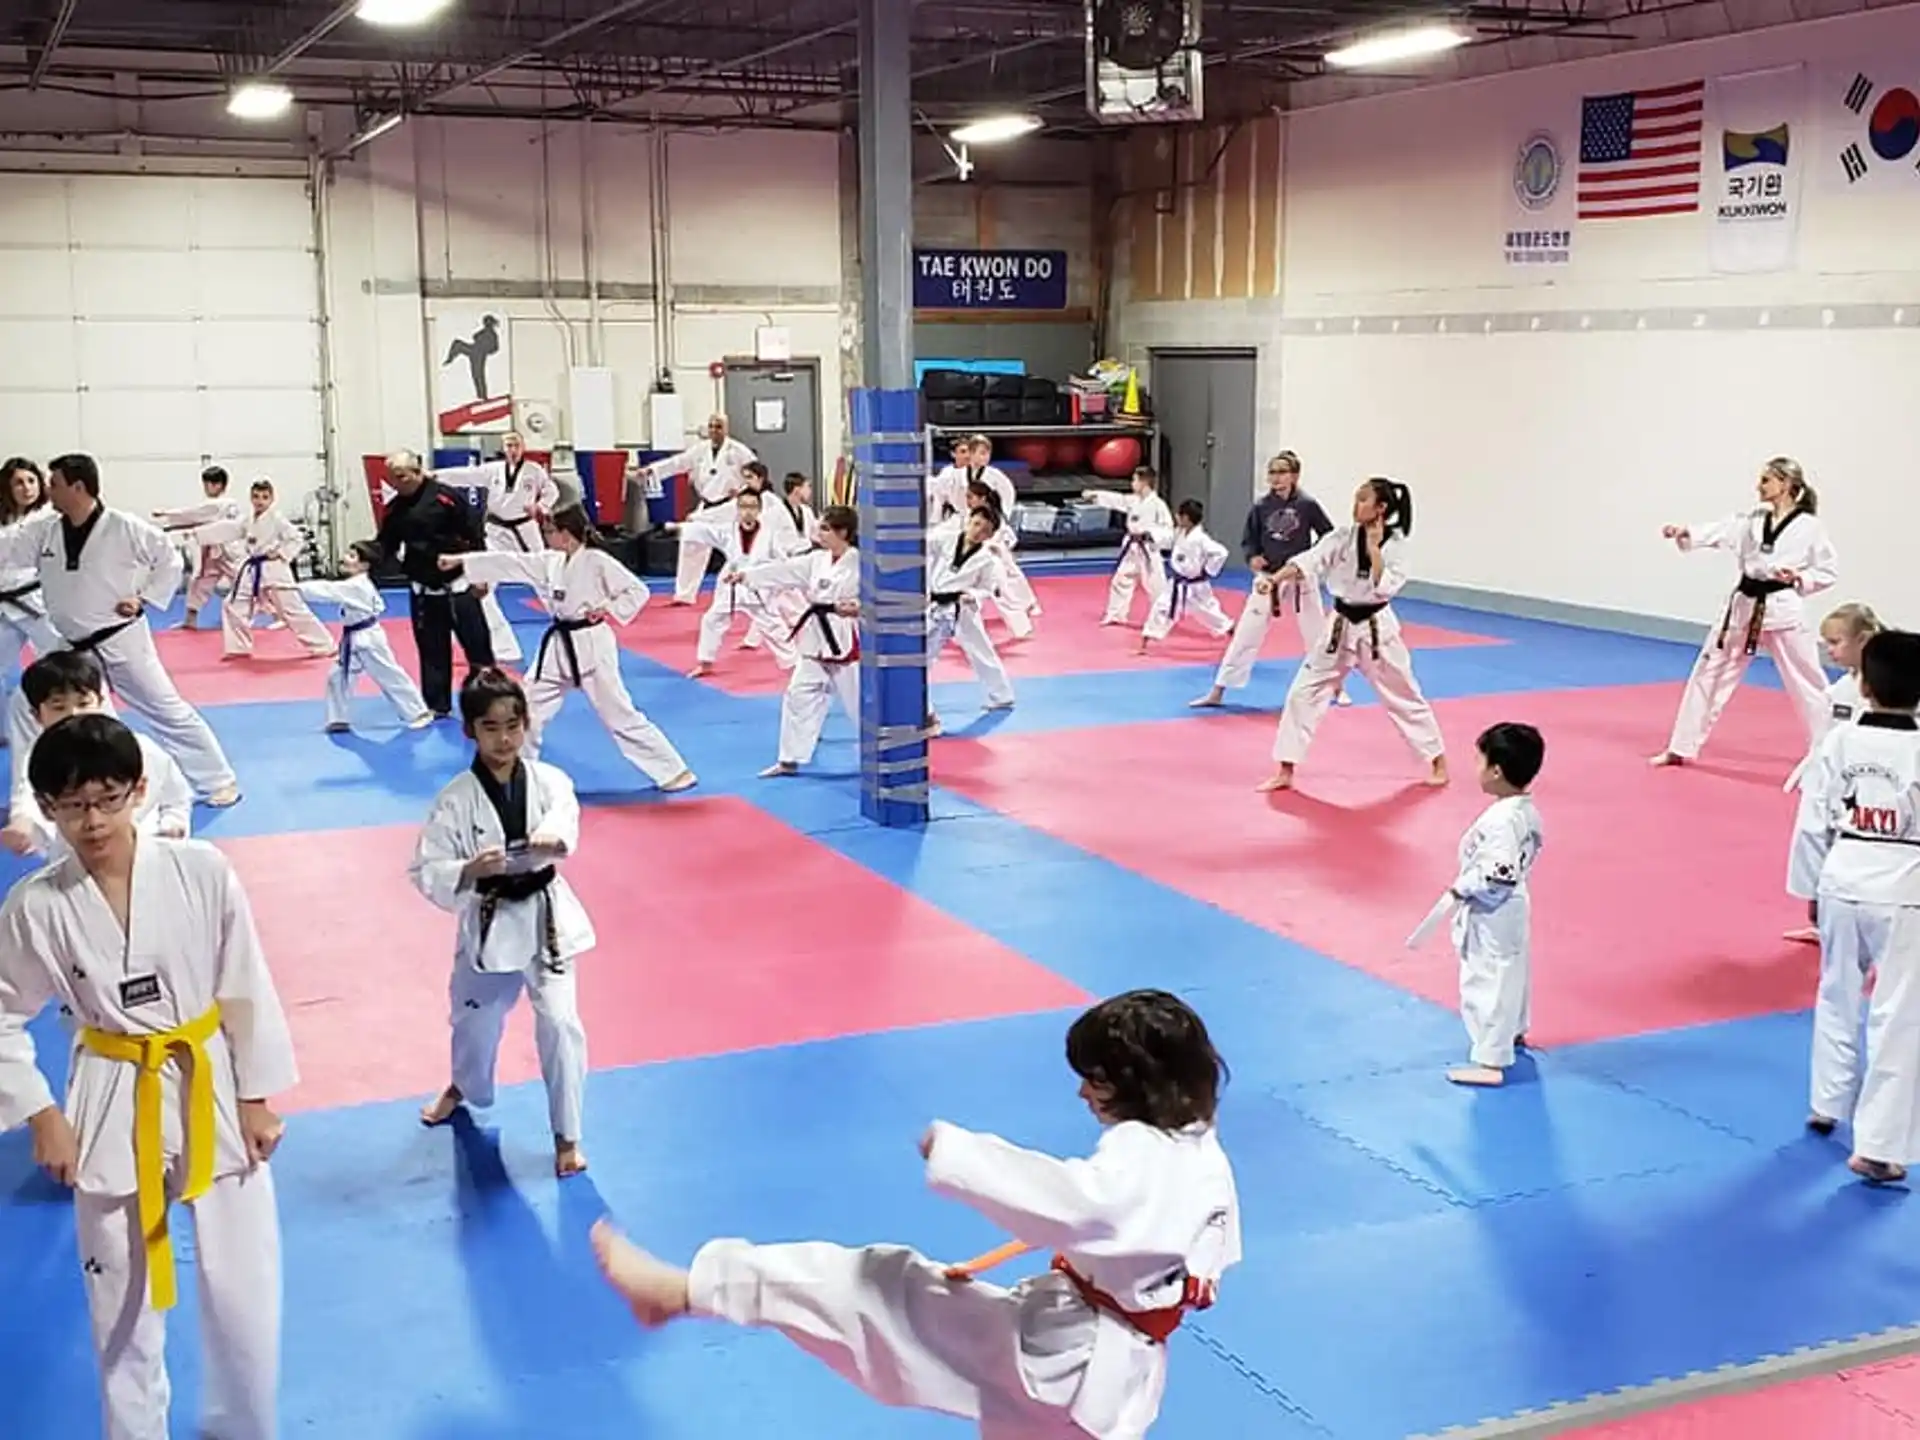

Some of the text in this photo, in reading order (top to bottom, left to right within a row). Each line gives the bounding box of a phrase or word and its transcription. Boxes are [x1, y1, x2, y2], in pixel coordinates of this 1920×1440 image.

[1728, 173, 1782, 199] 국기원
[919, 256, 1052, 279] TAE KWON DO
